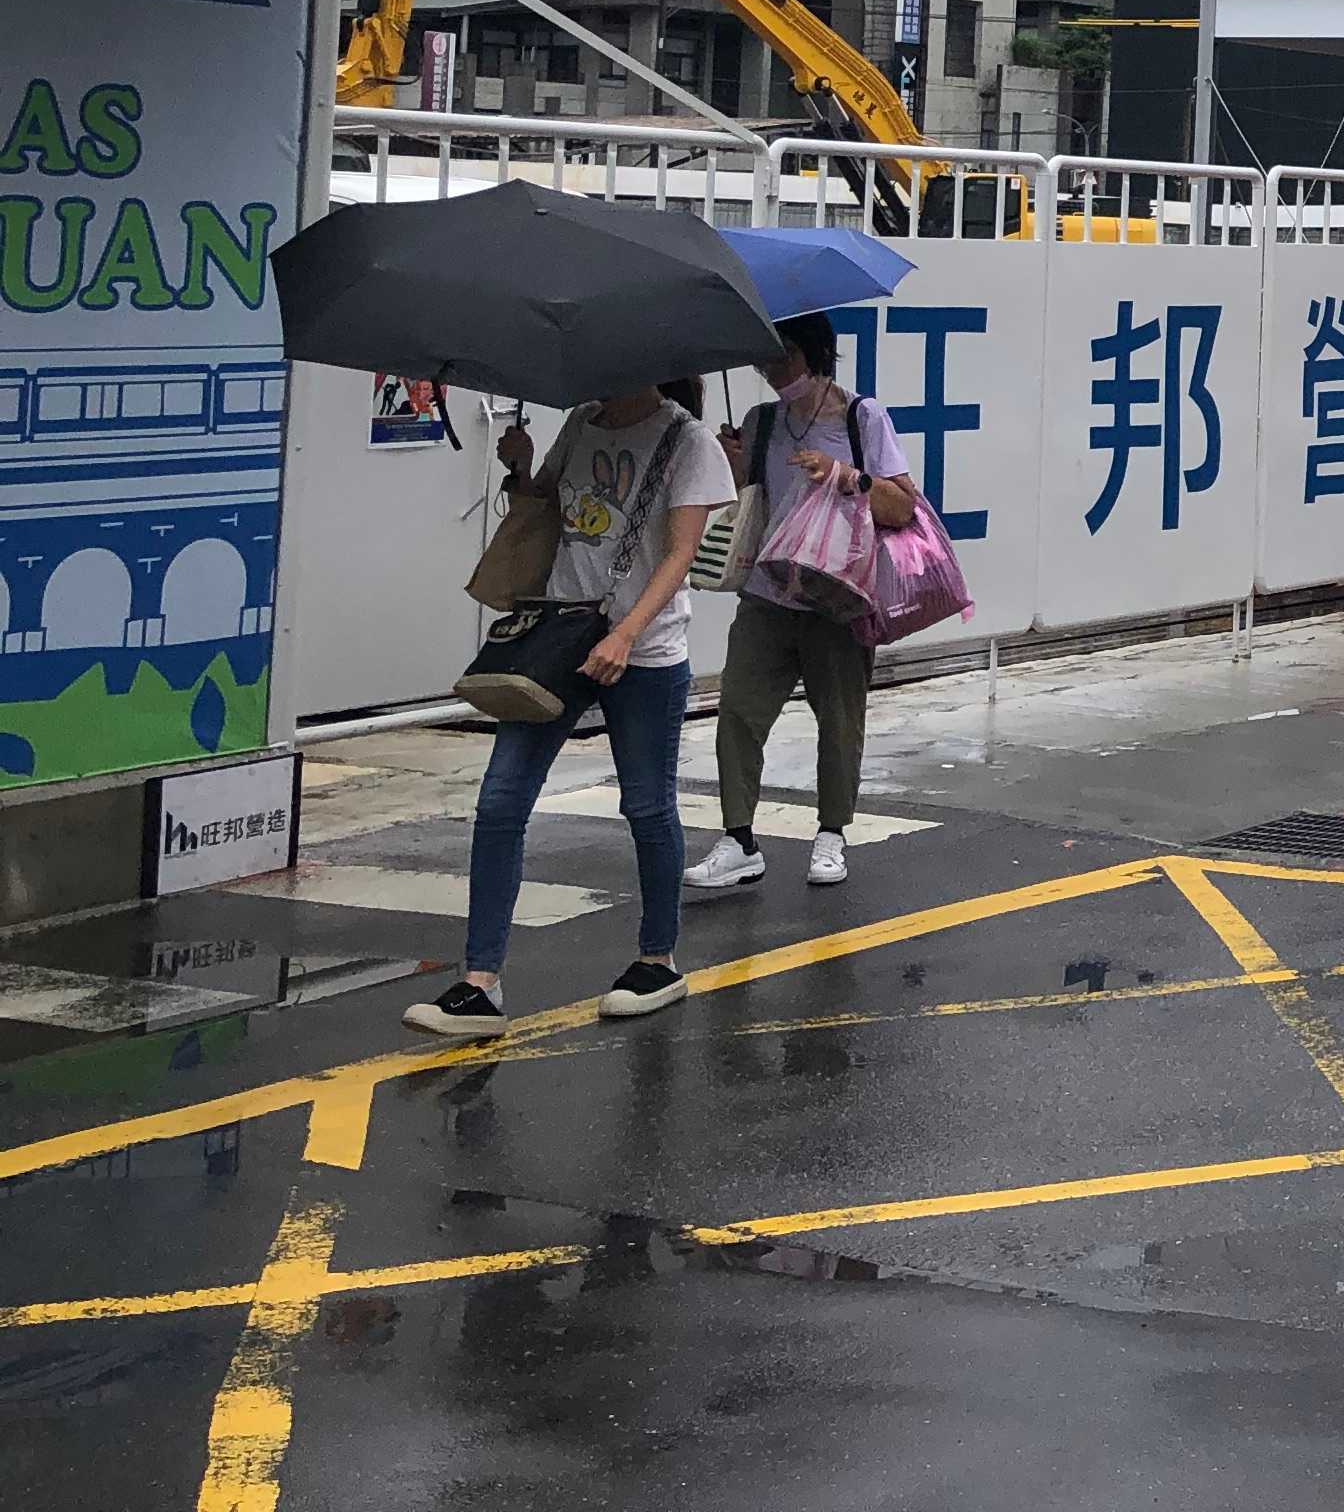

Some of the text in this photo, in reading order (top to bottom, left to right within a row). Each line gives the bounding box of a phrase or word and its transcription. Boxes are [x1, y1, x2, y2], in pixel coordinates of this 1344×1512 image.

[0, 78, 143, 179] AS
[0, 194, 278, 314] UAN
[200, 808, 286, 847] 旺邦營造
